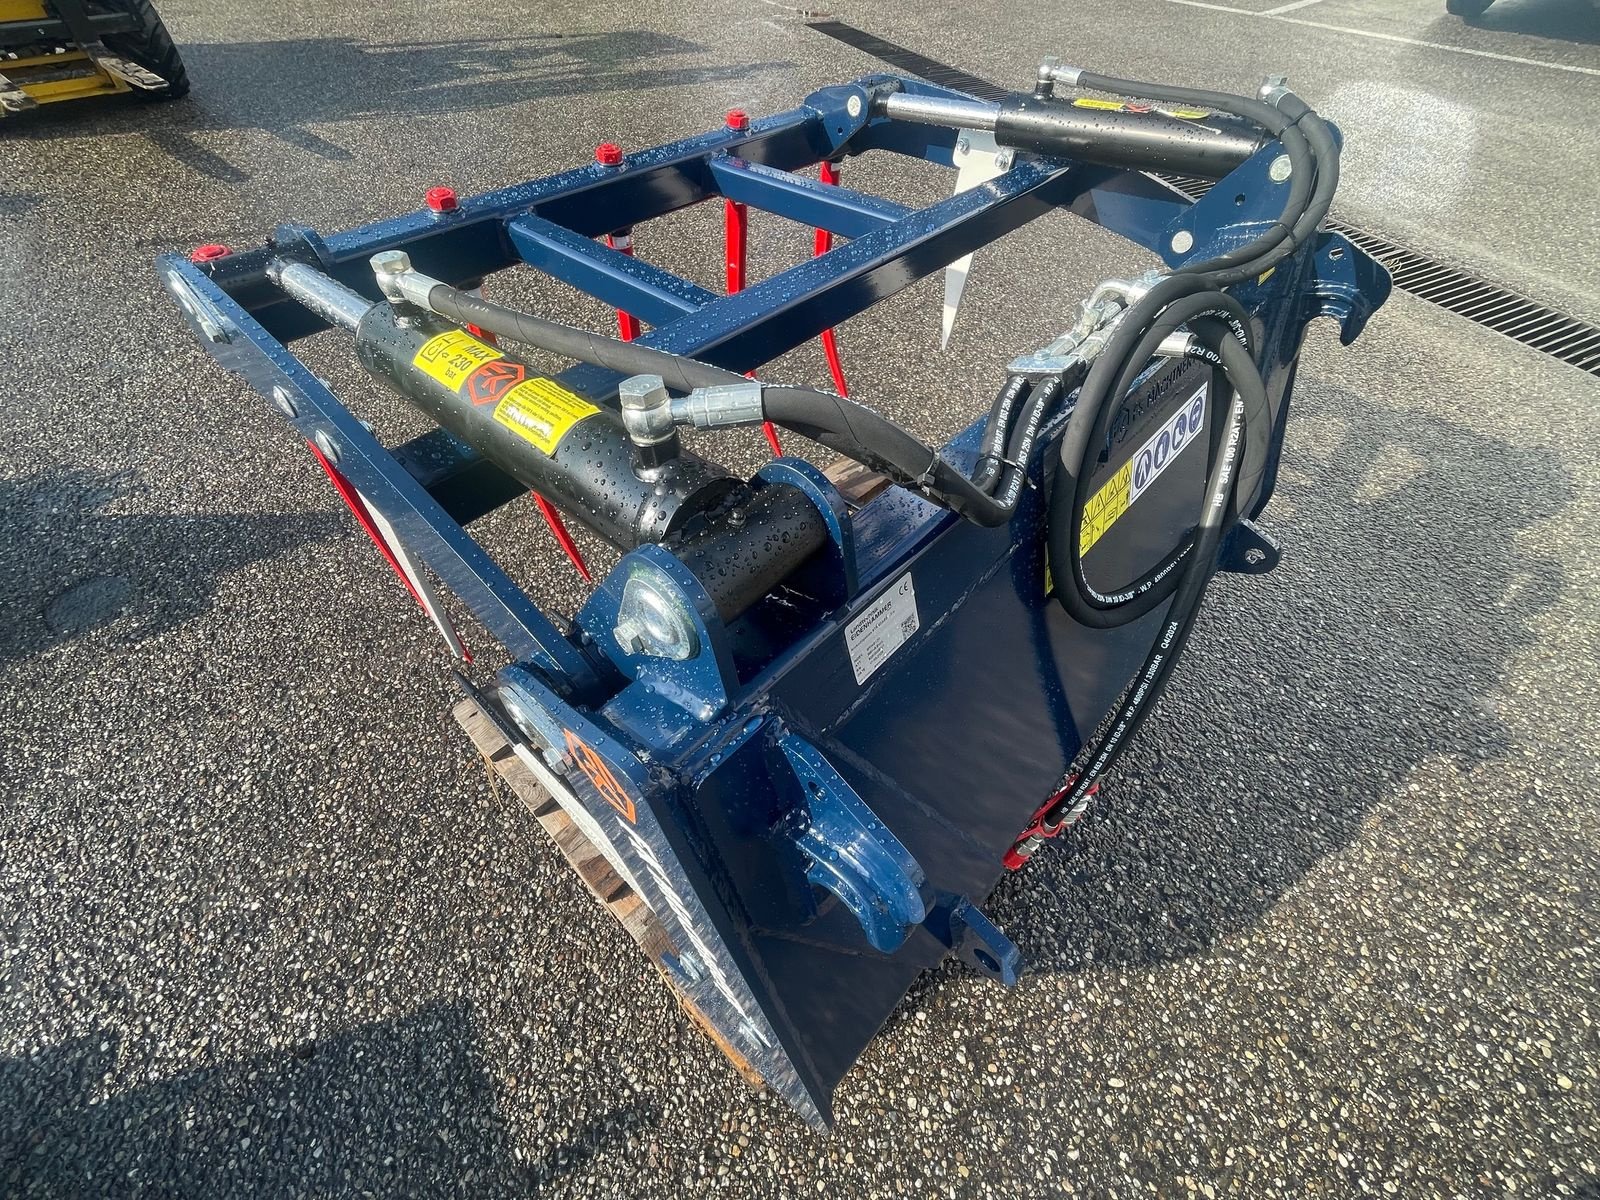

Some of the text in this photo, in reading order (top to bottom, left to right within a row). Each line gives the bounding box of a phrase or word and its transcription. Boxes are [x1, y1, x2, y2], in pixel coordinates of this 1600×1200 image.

[462, 345, 493, 361] MAX
[448, 354, 473, 372] 230
[444, 368, 457, 380] bar
[1229, 422, 1242, 447] R2AT
[1224, 447, 1237, 463] 100
[1219, 464, 1232, 484] SAE
[1212, 493, 1225, 507] HB
[1145, 654, 1164, 681] 330BAR
[1160, 621, 1179, 650] Q4/2024
